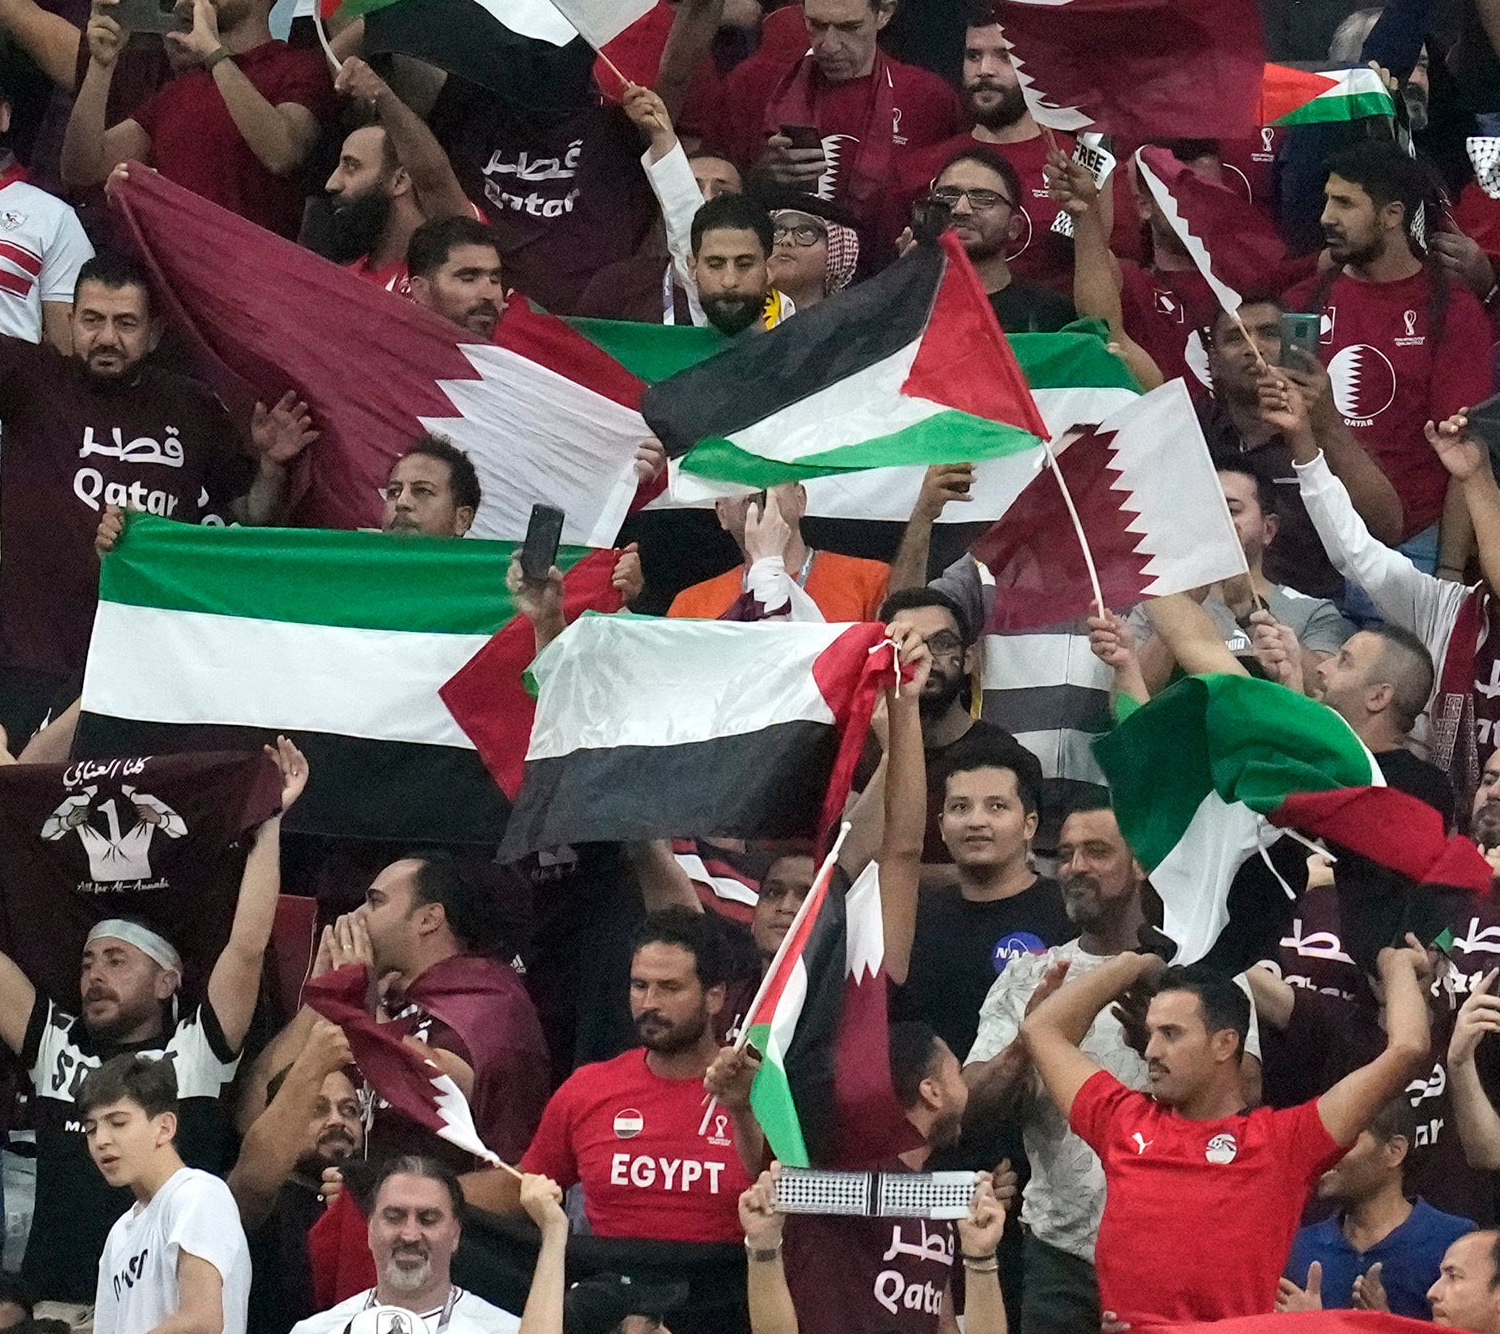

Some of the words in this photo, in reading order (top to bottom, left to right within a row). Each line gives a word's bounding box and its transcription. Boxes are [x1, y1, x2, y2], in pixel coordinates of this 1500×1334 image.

[1344, 418, 1373, 428] QATAR
[80, 426, 183, 467] قطر
[74, 468, 177, 516] Qatar
[609, 1154, 725, 1194] EGYPT
[874, 1271, 942, 1314] Qata
